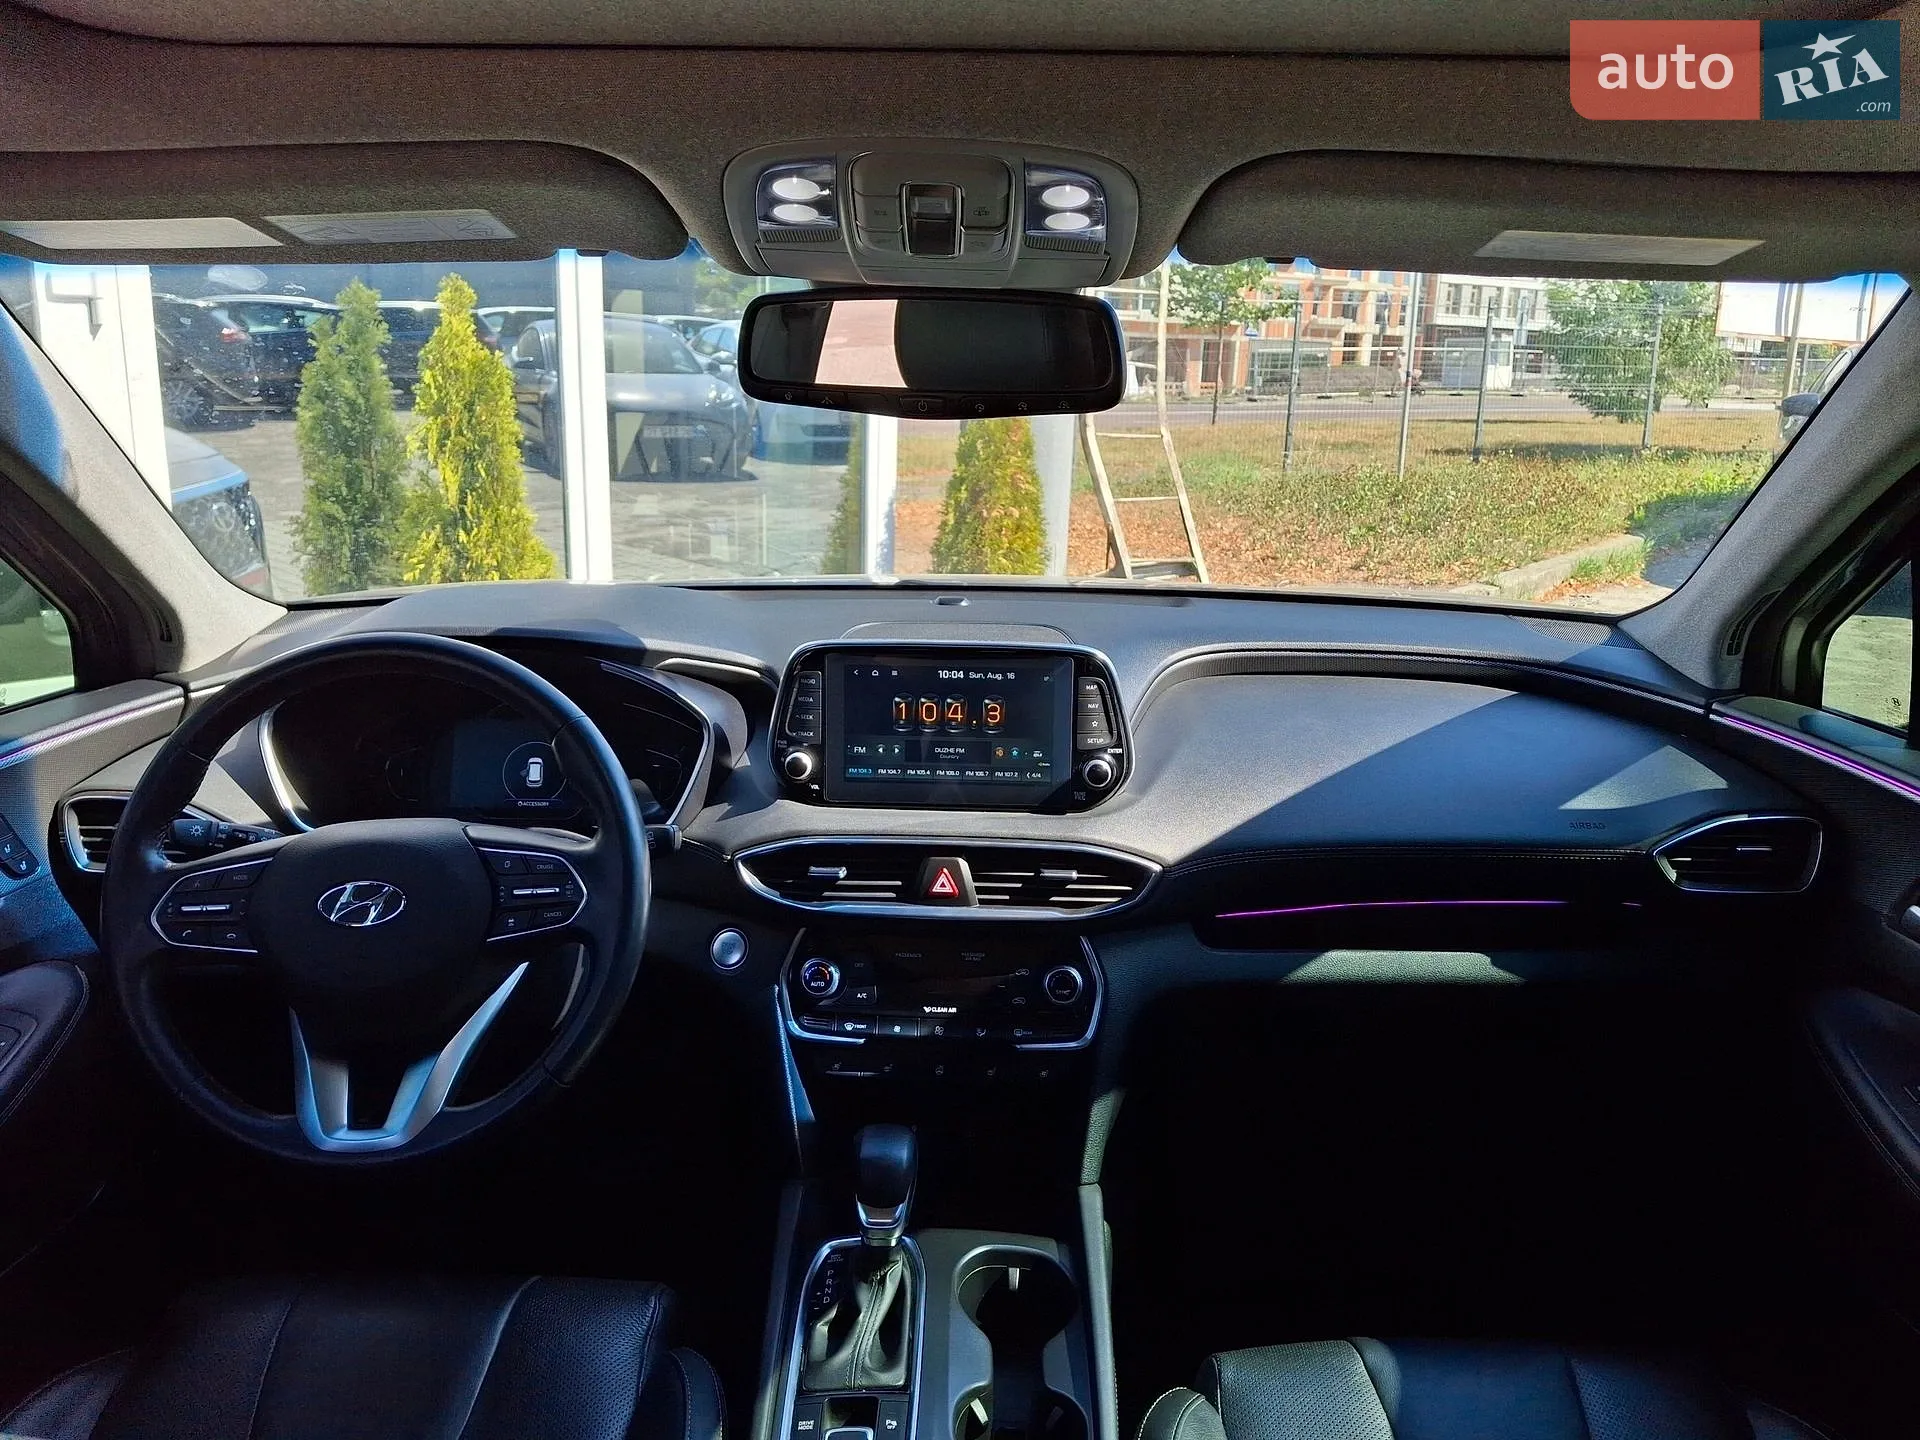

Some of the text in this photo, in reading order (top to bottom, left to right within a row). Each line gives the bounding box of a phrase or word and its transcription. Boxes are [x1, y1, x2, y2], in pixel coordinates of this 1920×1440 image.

[937, 670, 1016, 681] 10:04 Sun, Aug. 16
[853, 746, 867, 754] FM
[1569, 821, 1607, 830] AIRBAG
[827, 1269, 834, 1277] P
[823, 1296, 831, 1304] D
